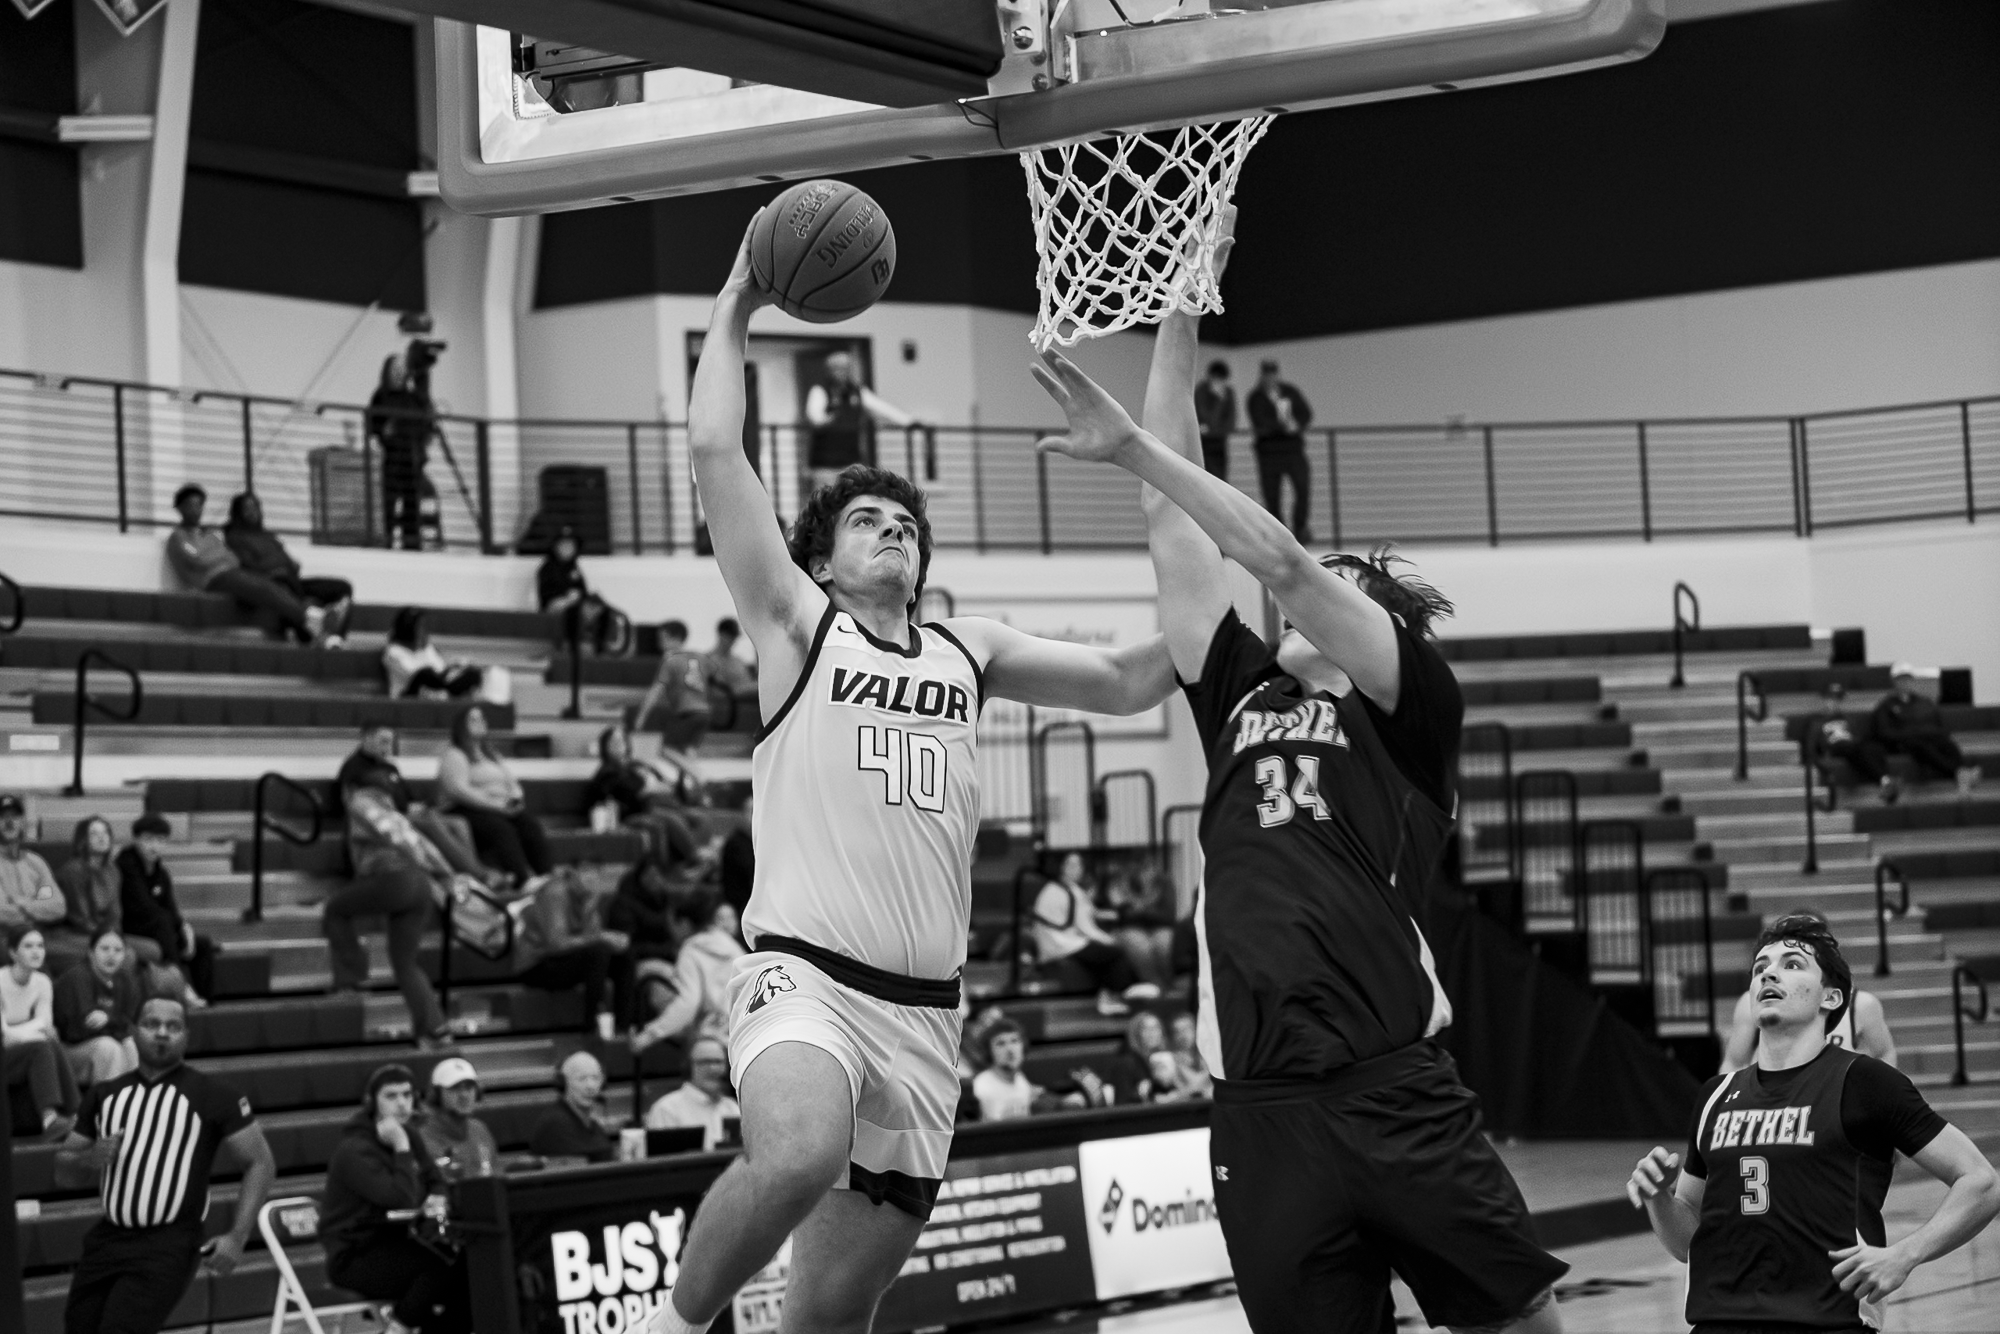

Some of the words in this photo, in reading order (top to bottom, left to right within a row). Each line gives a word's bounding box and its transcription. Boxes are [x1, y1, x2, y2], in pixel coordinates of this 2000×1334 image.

[816, 201, 880, 269] ALDING
[829, 666, 969, 724] VALOR
[858, 725, 947, 814] 40
[1255, 754, 1332, 828] 34
[1710, 1105, 1815, 1151] BETHEL
[1739, 1155, 1770, 1216] 3
[551, 1221, 659, 1302] BJS
[558, 1287, 673, 1334] TROPH
